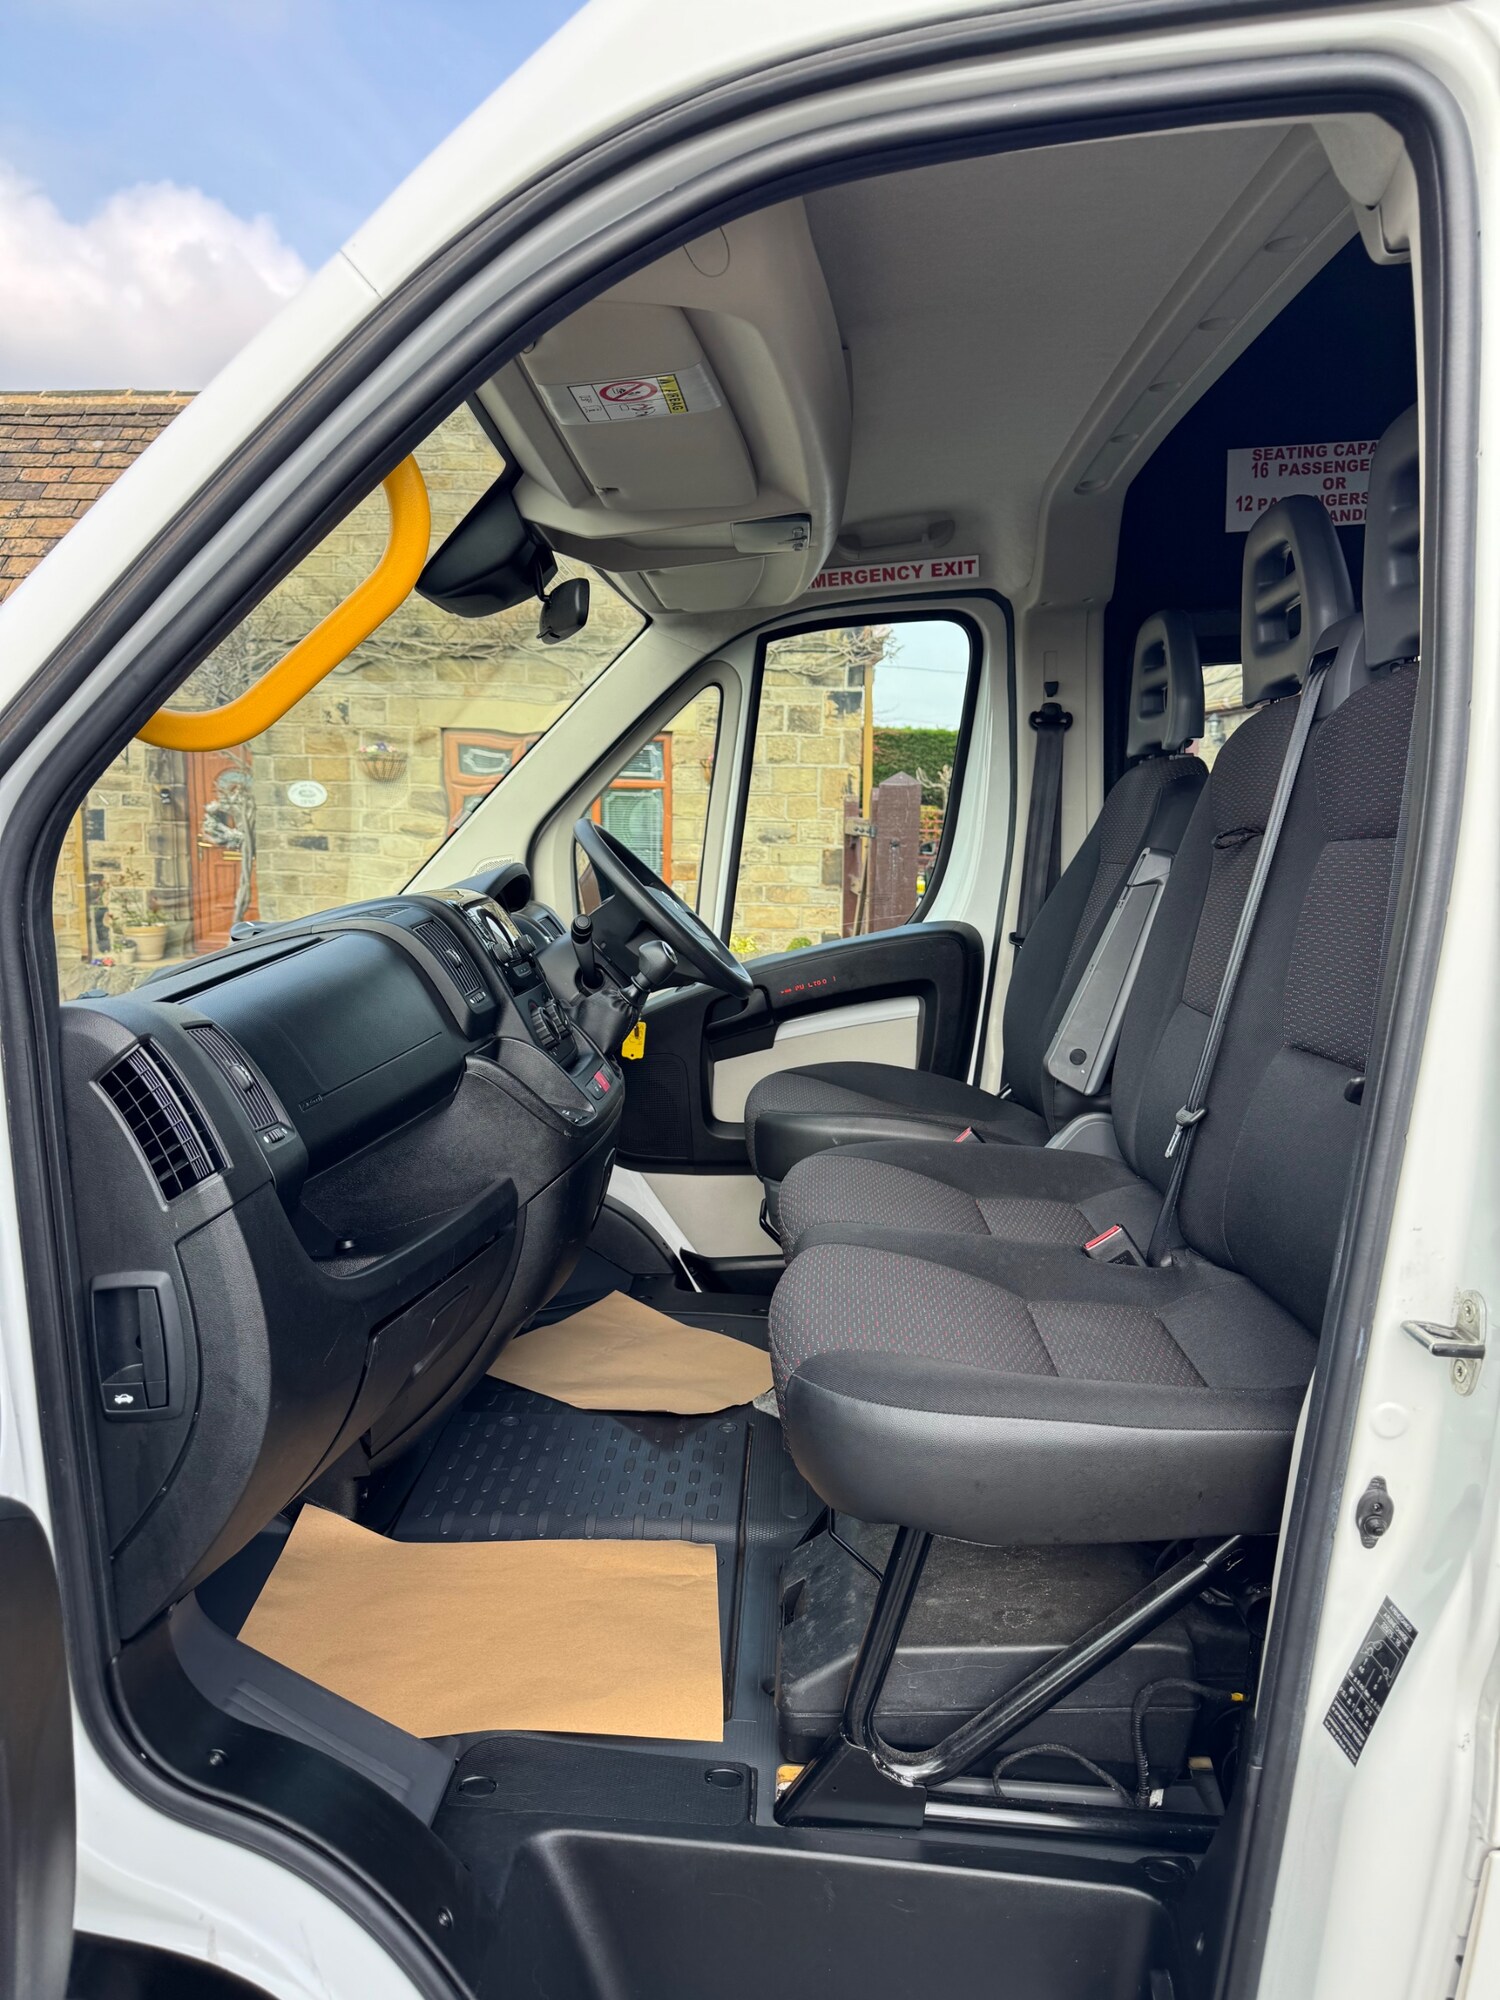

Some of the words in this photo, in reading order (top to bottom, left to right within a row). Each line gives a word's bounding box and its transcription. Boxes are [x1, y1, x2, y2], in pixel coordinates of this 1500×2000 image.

[1252, 445, 1328, 462] SEATING
[1252, 462, 1269, 478] 16
[1322, 477, 1346, 490] OR
[1235, 495, 1253, 512] 12
[808, 564, 924, 589] MERGENCY
[931, 559, 977, 577] EXIT
